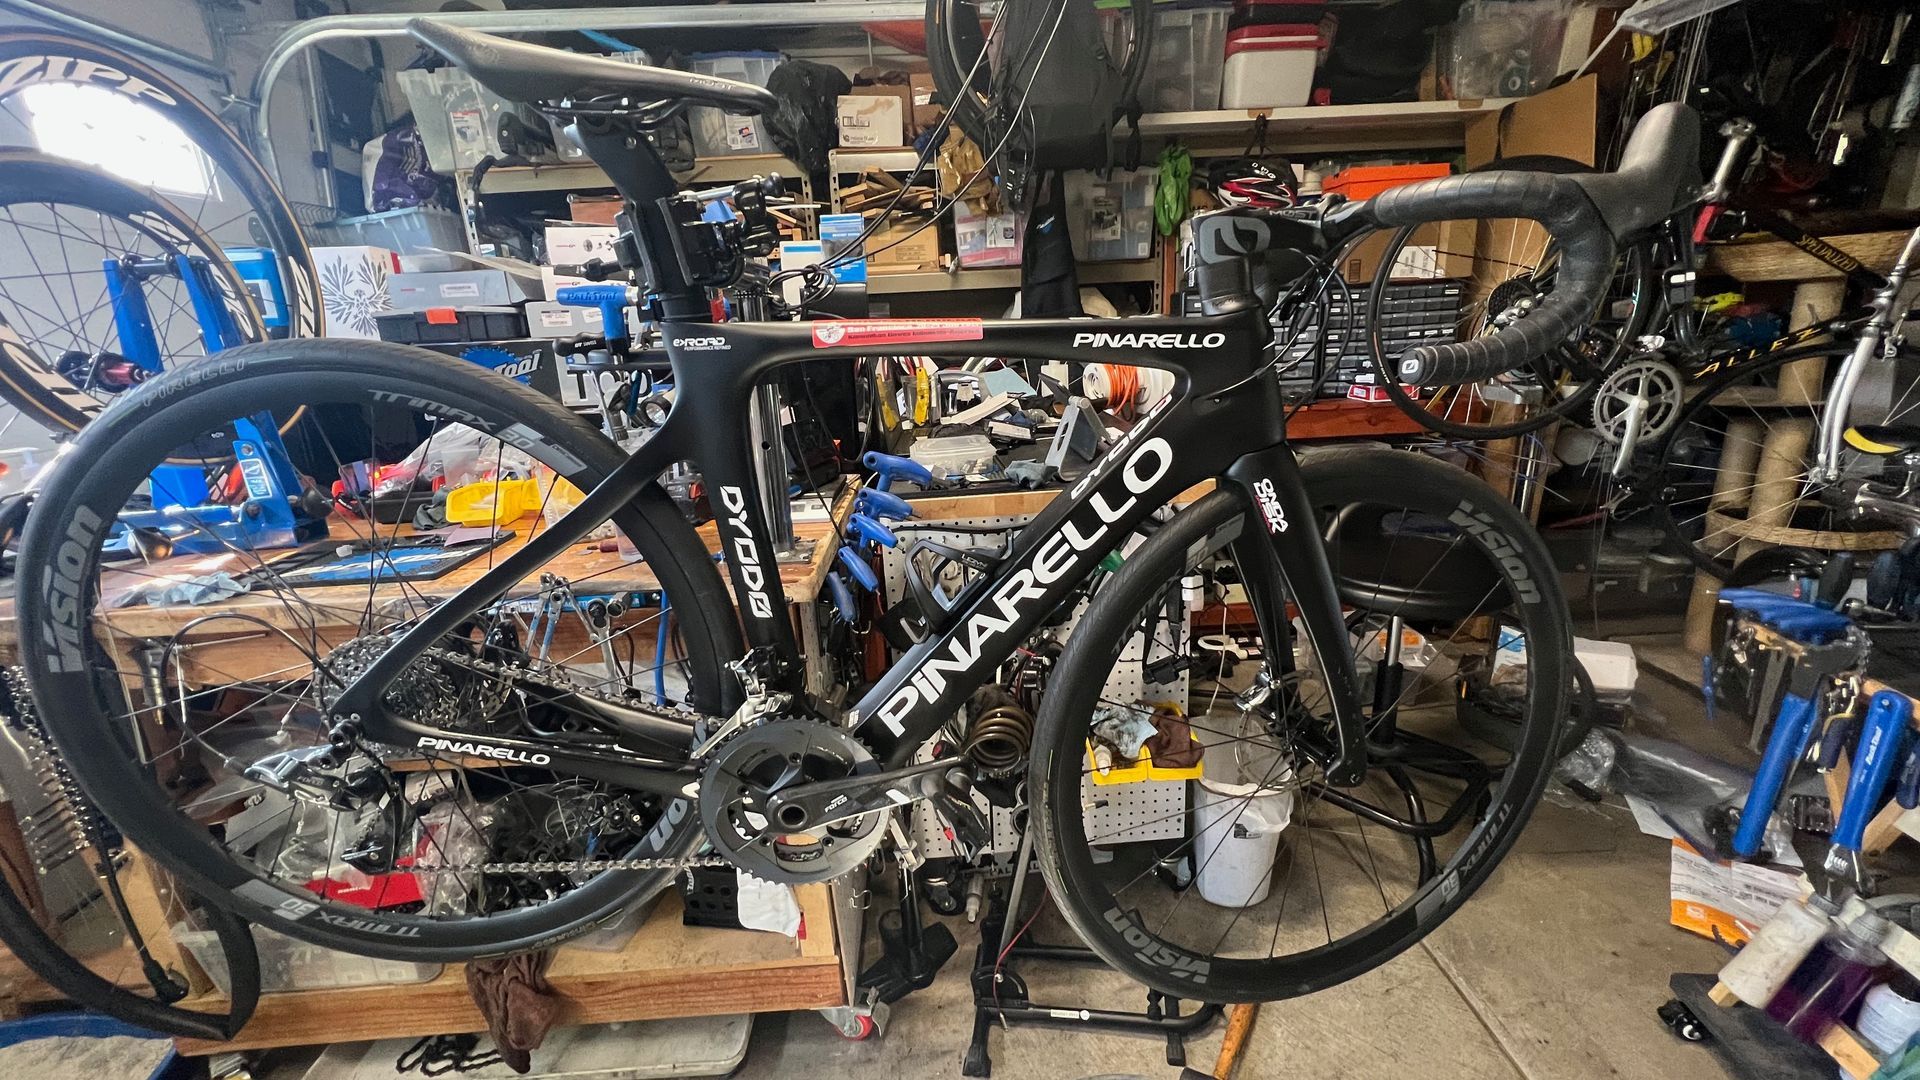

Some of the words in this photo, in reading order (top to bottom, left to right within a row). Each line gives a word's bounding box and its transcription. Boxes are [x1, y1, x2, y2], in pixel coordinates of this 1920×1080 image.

[1072, 333, 1226, 348] PINARELLO
[1262, 478, 1289, 533] ONDA
[876, 436, 1173, 738] PINARELLO
[416, 736, 551, 766] PINARELLO
